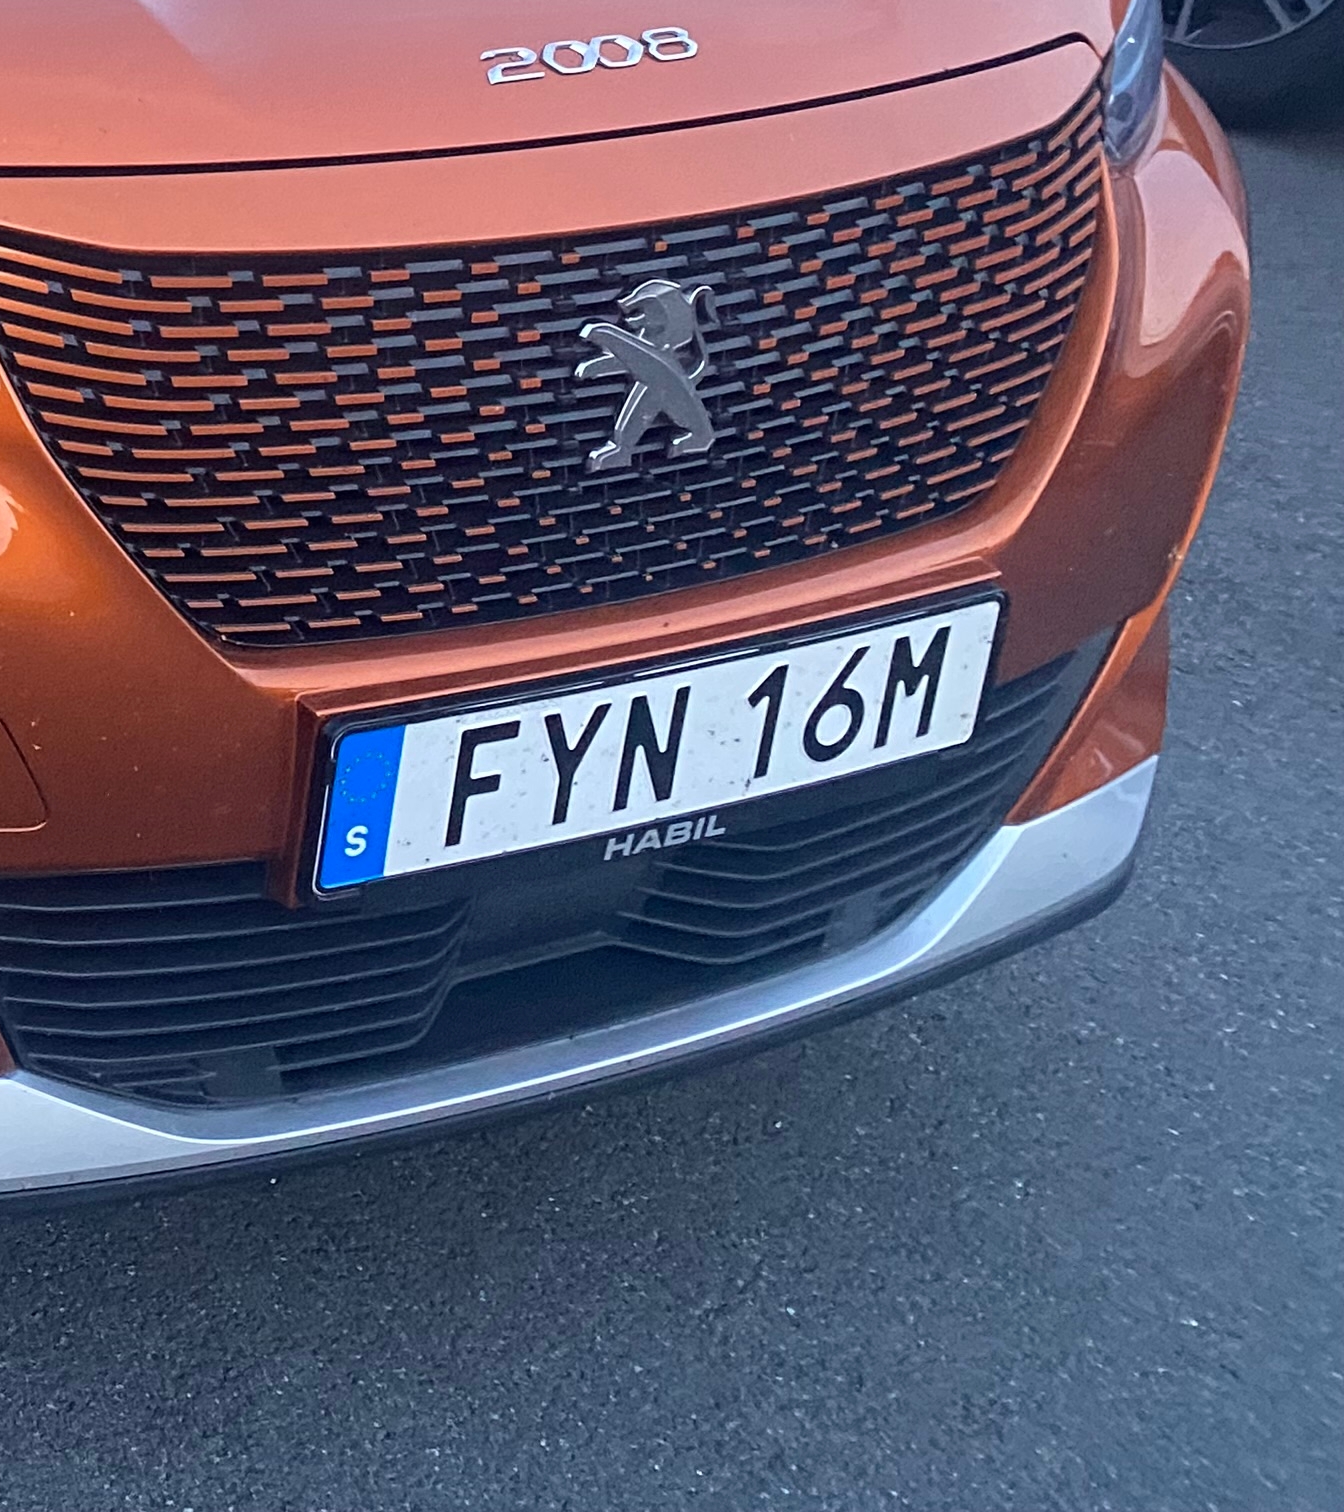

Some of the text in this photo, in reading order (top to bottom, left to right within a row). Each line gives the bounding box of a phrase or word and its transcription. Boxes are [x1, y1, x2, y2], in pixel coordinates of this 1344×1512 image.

[479, 26, 698, 85] 2008
[443, 625, 952, 847] FYN 16M
[343, 824, 368, 858] S
[603, 815, 727, 861] HABIL
